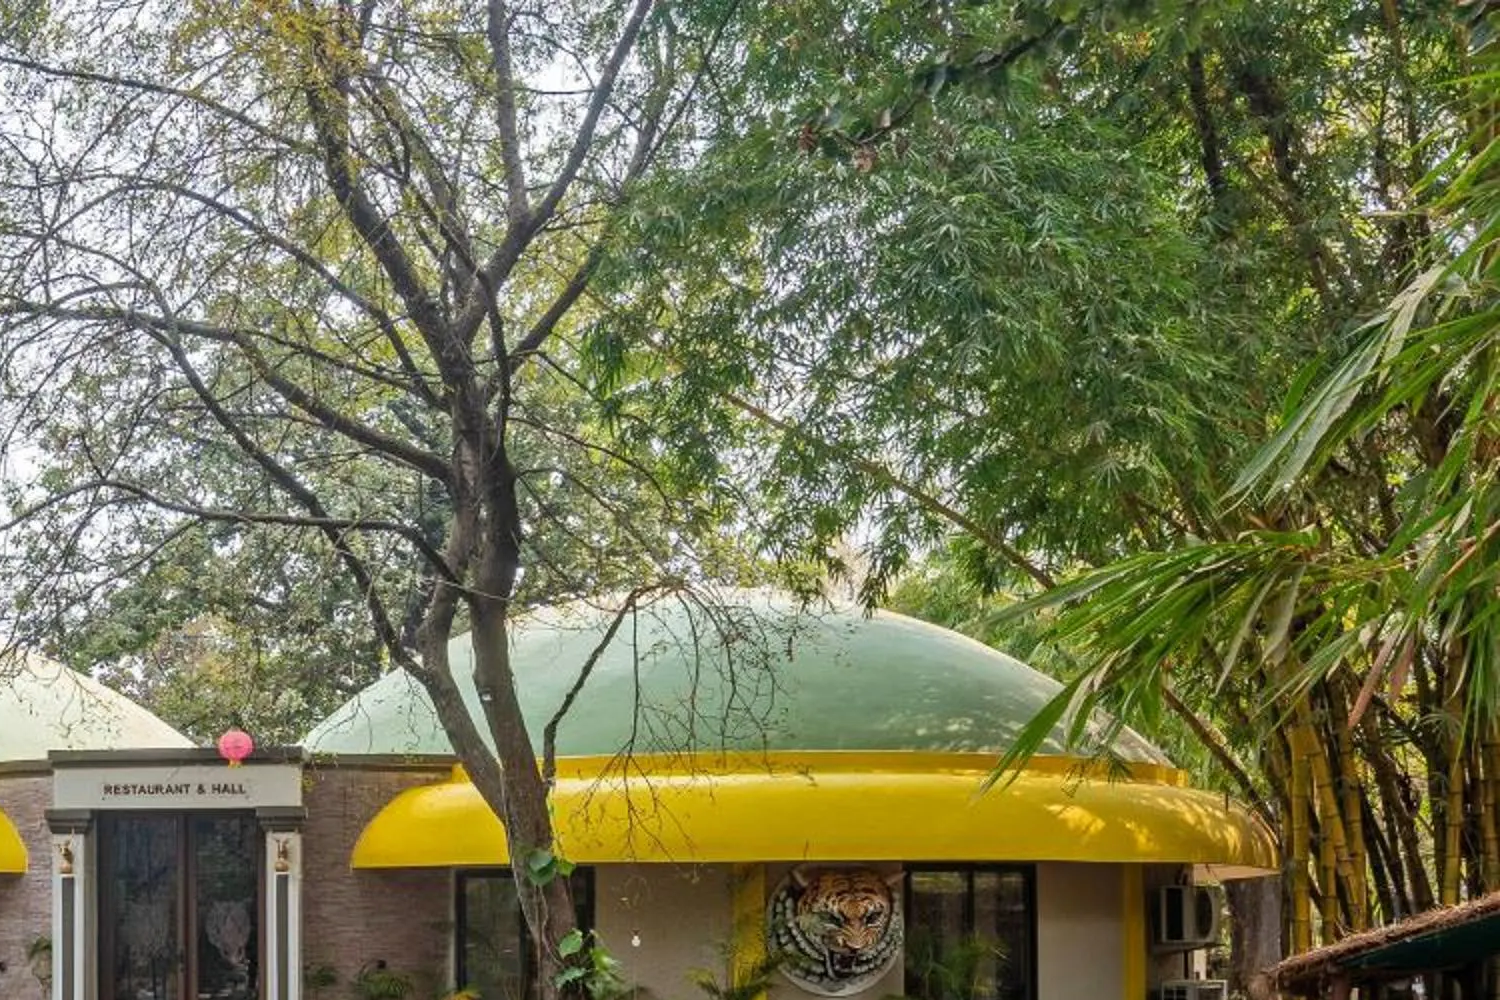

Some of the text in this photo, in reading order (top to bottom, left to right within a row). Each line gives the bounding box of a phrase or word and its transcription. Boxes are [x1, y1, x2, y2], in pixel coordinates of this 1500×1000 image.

[103, 783, 247, 795] RESTAURANT & HALL
